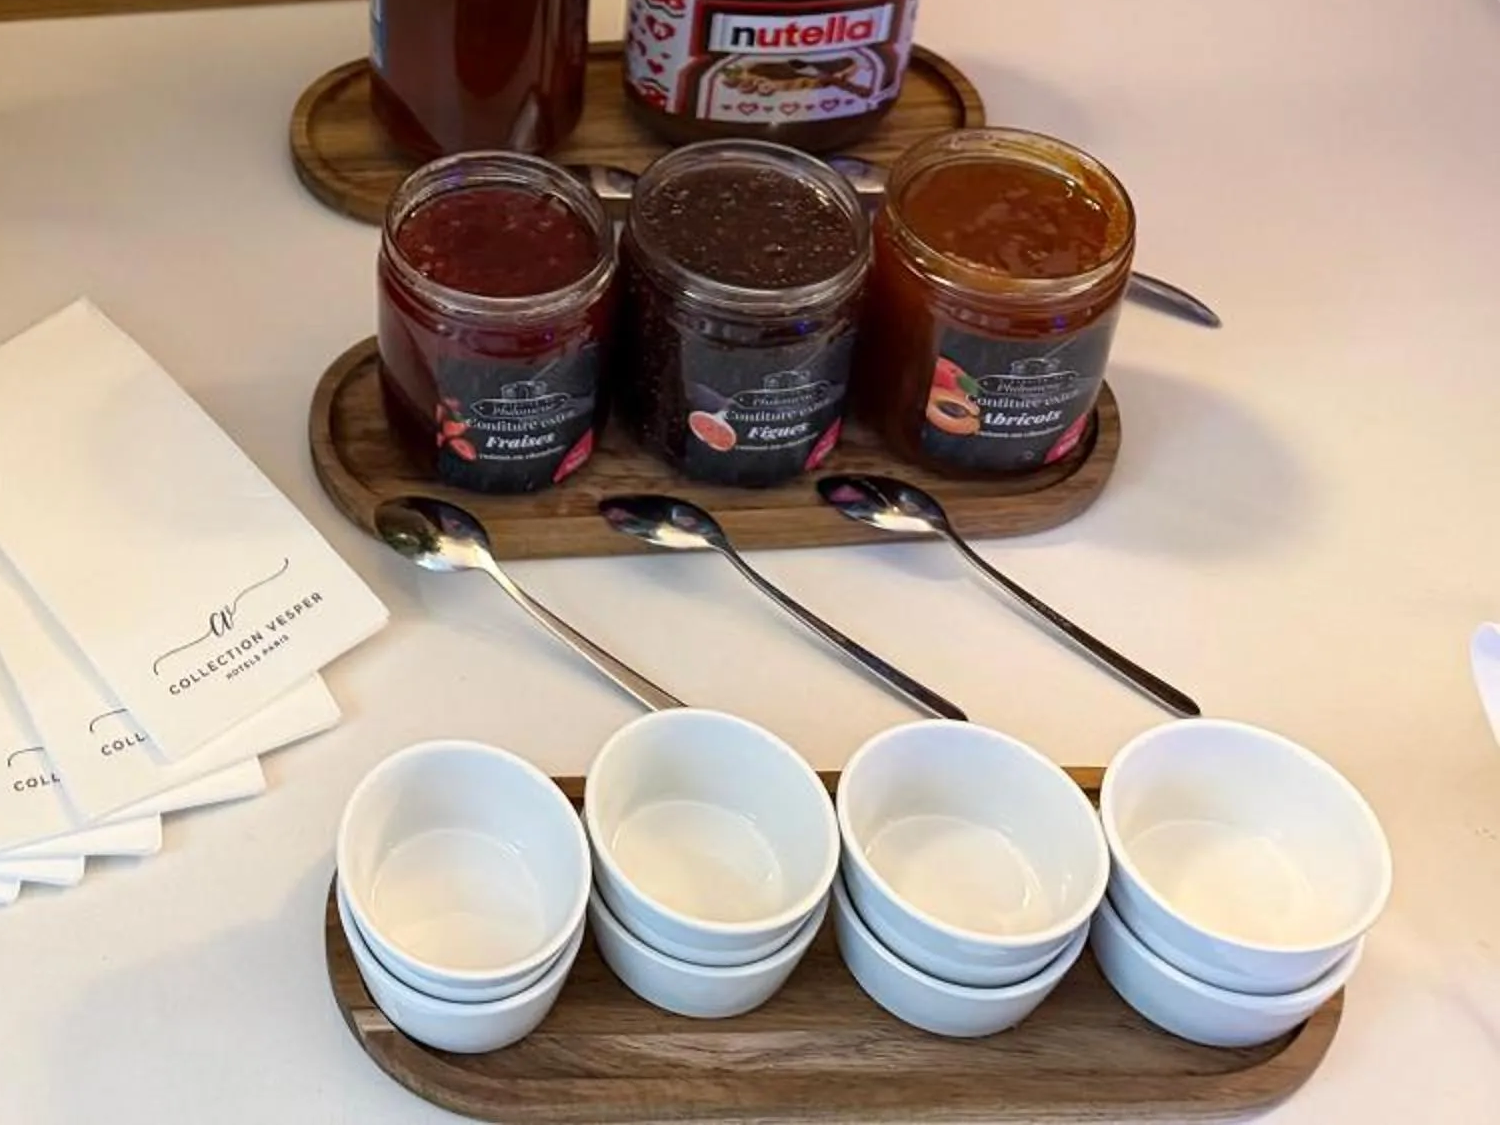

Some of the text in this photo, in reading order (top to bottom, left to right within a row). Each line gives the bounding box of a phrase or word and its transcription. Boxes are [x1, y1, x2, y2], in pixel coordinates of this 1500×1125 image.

[731, 15, 874, 46] nutella
[983, 409, 1063, 426] Abricots
[486, 433, 555, 448] Fraises
[747, 422, 811, 440] Figues
[169, 591, 323, 695] COLLECTION VESPER
[226, 633, 290, 680] HOTELS PARIS
